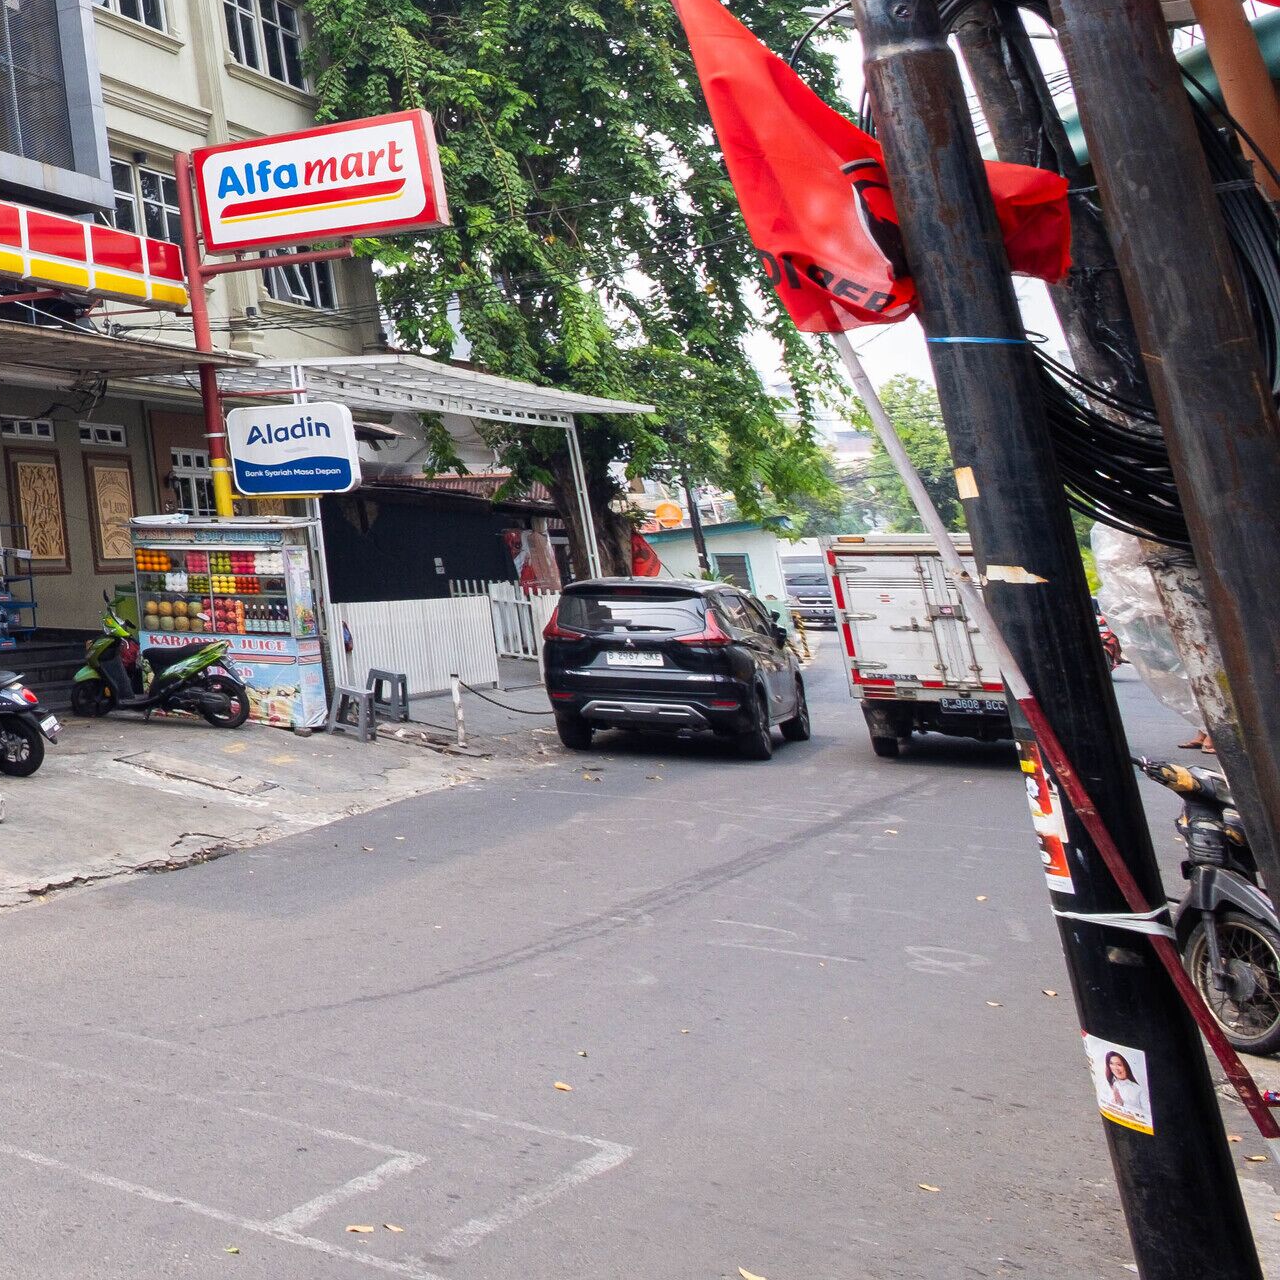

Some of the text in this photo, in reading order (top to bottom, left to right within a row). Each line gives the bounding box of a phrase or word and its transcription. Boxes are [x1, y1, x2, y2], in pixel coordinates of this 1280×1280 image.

[218, 140, 404, 200] Alfamart
[246, 416, 331, 446] Aladin
[245, 467, 342, 478] Bank Syariah Masa Depan
[241, 638, 287, 652] JUICE
